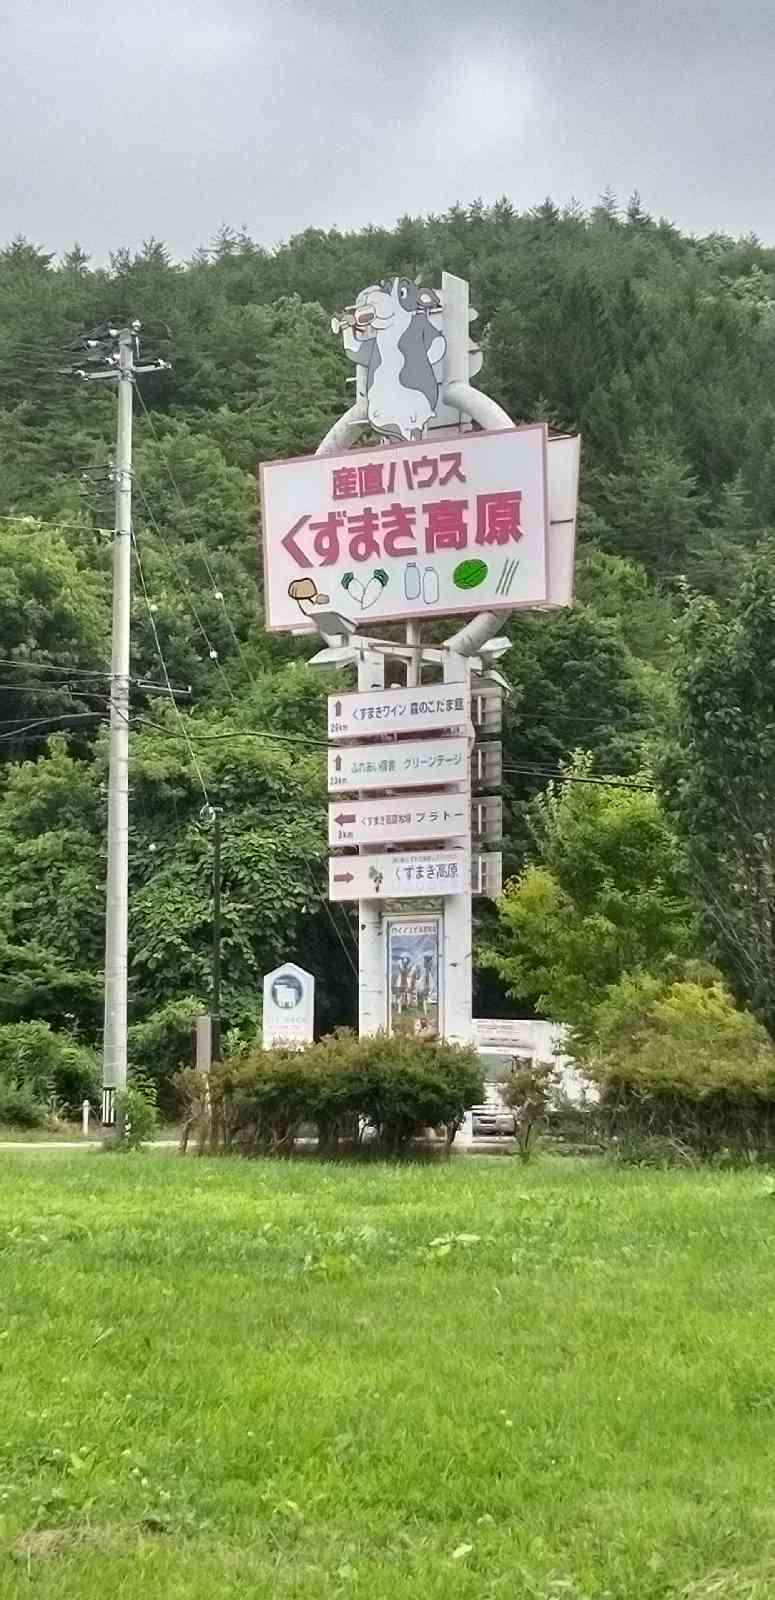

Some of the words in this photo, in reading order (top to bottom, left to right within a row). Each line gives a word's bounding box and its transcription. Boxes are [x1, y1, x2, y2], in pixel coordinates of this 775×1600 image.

[332, 451, 466, 501] 産直ハウス
[281, 490, 524, 569] くずまき高原
